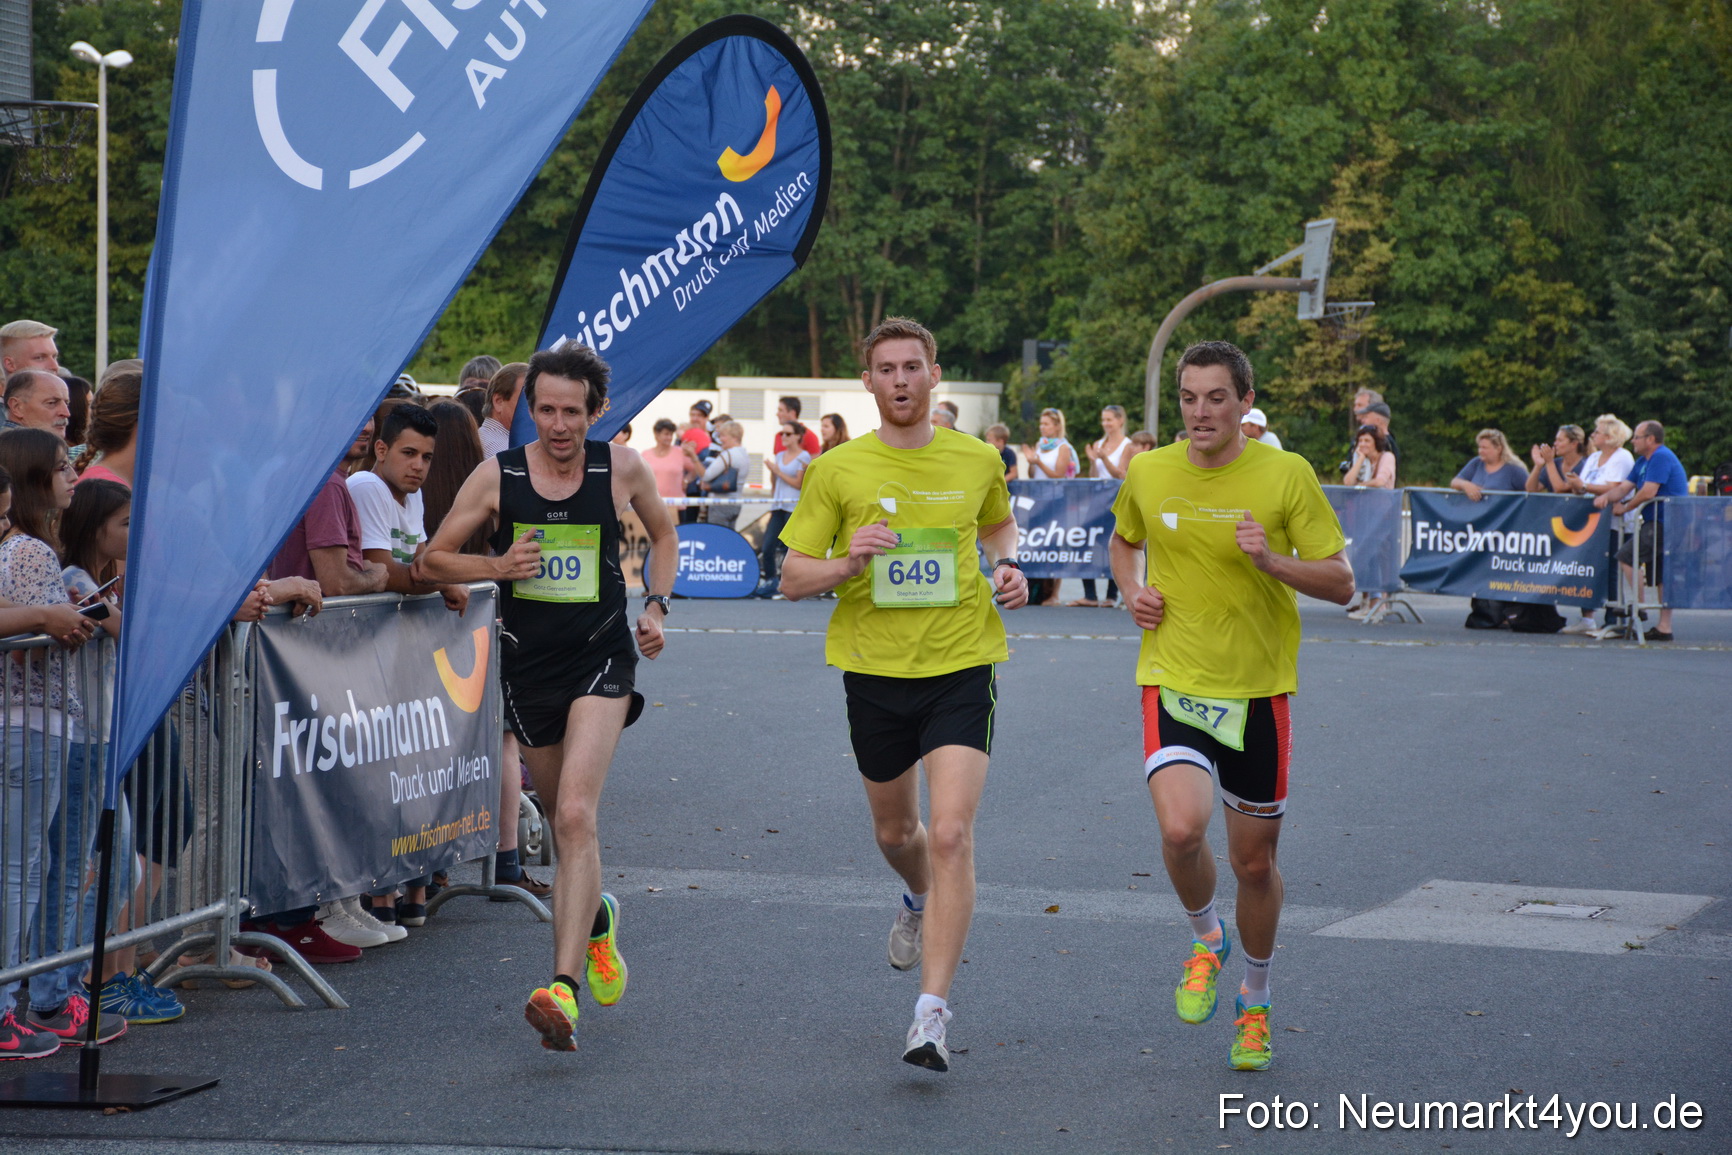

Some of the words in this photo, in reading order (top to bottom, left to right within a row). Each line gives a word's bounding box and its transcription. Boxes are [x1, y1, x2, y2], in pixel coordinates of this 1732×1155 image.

[338, 0, 484, 113] FI
[672, 257, 719, 312] Druck
[753, 171, 811, 241] Medien
[549, 192, 743, 355] ischmann
[547, 511, 568, 519] GORE
[1017, 520, 1104, 547] scher
[1416, 521, 1552, 556] Frischmann
[680, 555, 746, 572] Fischer
[687, 573, 743, 581] AUTOMOBILE
[888, 559, 940, 585] 649
[1491, 555, 1525, 573] Druck
[1528, 560, 1551, 574] und
[1551, 561, 1594, 577] Medien
[1489, 580, 1594, 598] www.frischmann-net.de
[1178, 697, 1229, 729] 637
[273, 690, 450, 778] Frischmann
[390, 765, 426, 804] Druck
[428, 756, 453, 795] und
